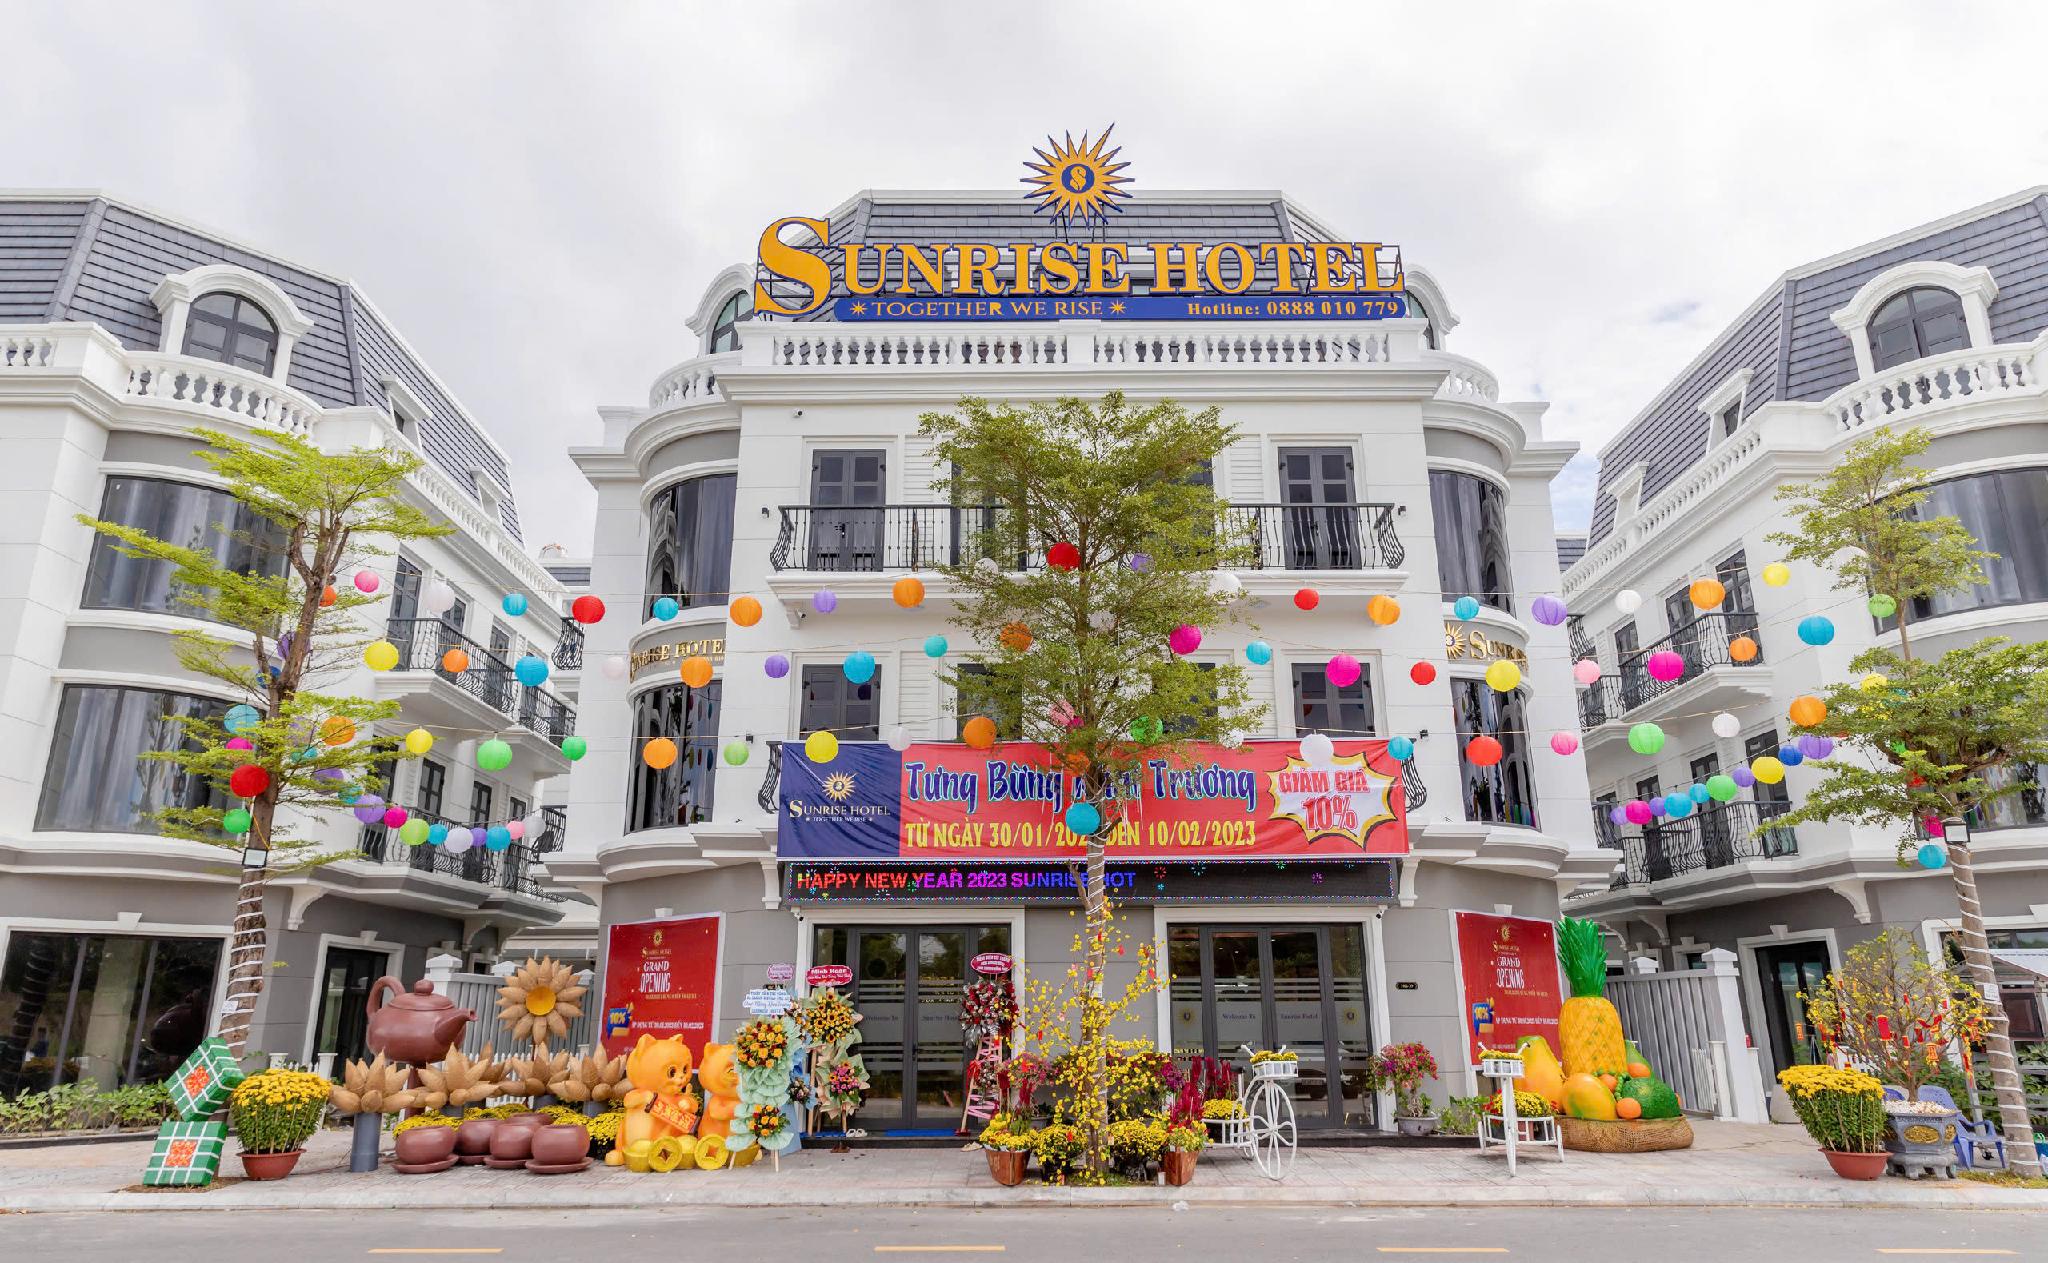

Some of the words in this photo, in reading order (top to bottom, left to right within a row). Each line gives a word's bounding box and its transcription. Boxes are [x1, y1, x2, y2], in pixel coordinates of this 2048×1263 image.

[754, 217, 1131, 317] SUNRISE
[1147, 242, 1405, 296] HOTEL
[872, 301, 1002, 316] TOGETHER
[1010, 302, 1046, 316] WE
[1055, 301, 1102, 315] RISE
[1188, 302, 1261, 315] Hotline:
[1267, 301, 1314, 315] 0888
[1321, 301, 1356, 315] 010
[1363, 301, 1398, 315] 779
[905, 759, 978, 814] Tưng
[987, 760, 1063, 814] Bừng
[789, 800, 847, 818] SUNRISE
[850, 804, 891, 817] HOTEL
[1301, 794, 1358, 831] 10%
[933, 817, 984, 848] NGÀY
[1149, 819, 1256, 846] 10/02/2023
[797, 872, 860, 889] HAPPY
[864, 872, 907, 889] NEW
[912, 872, 963, 889] YEAR
[967, 872, 1007, 889] 2023
[1011, 871, 1088, 889] SUNRISE
[643, 960, 670, 972] GRAND
[640, 972, 671, 993] OPENING
